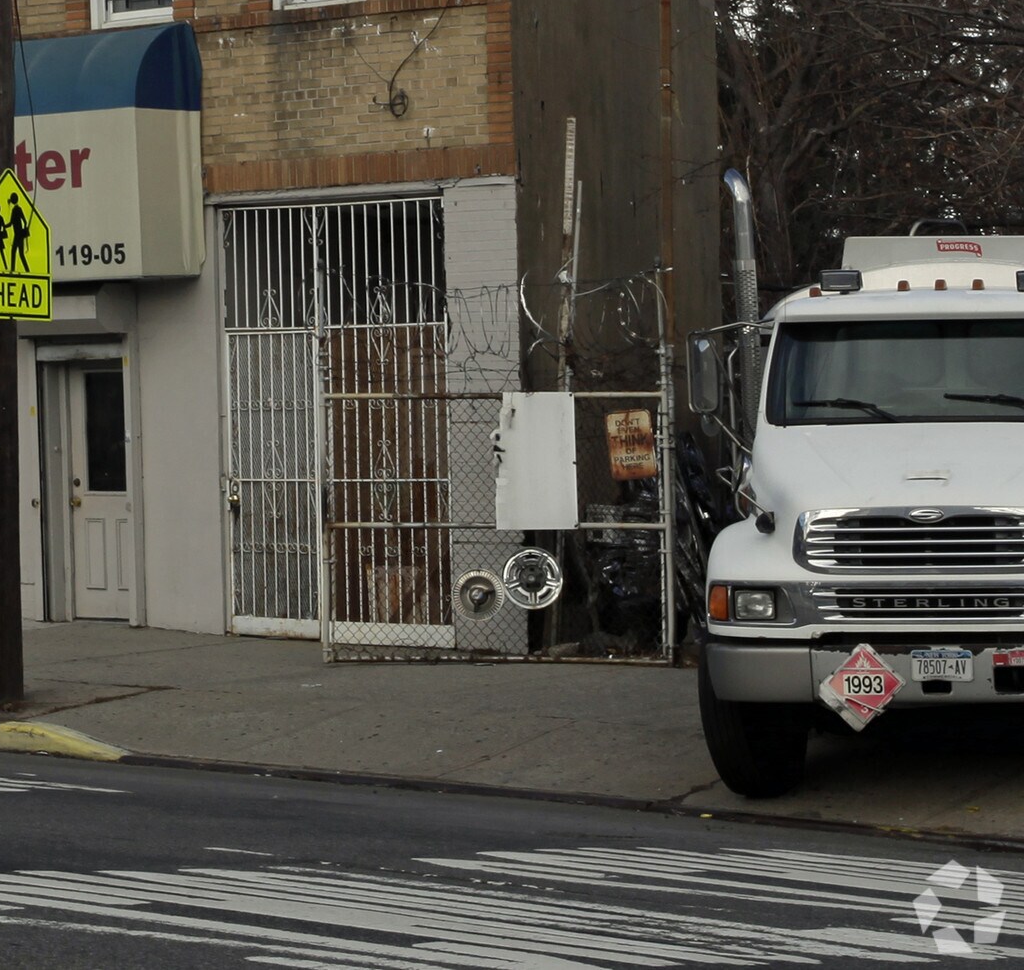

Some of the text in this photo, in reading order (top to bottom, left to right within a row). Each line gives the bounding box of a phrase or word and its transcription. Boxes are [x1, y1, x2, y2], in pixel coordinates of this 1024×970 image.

[939, 243, 979, 251] PROGRESS
[55, 243, 126, 266] 119-05
[615, 418, 640, 426] DON'T
[611, 433, 649, 447] THINK
[614, 454, 650, 462] PARKING
[852, 597, 1010, 608] STERLING
[844, 676, 883, 694] 1993
